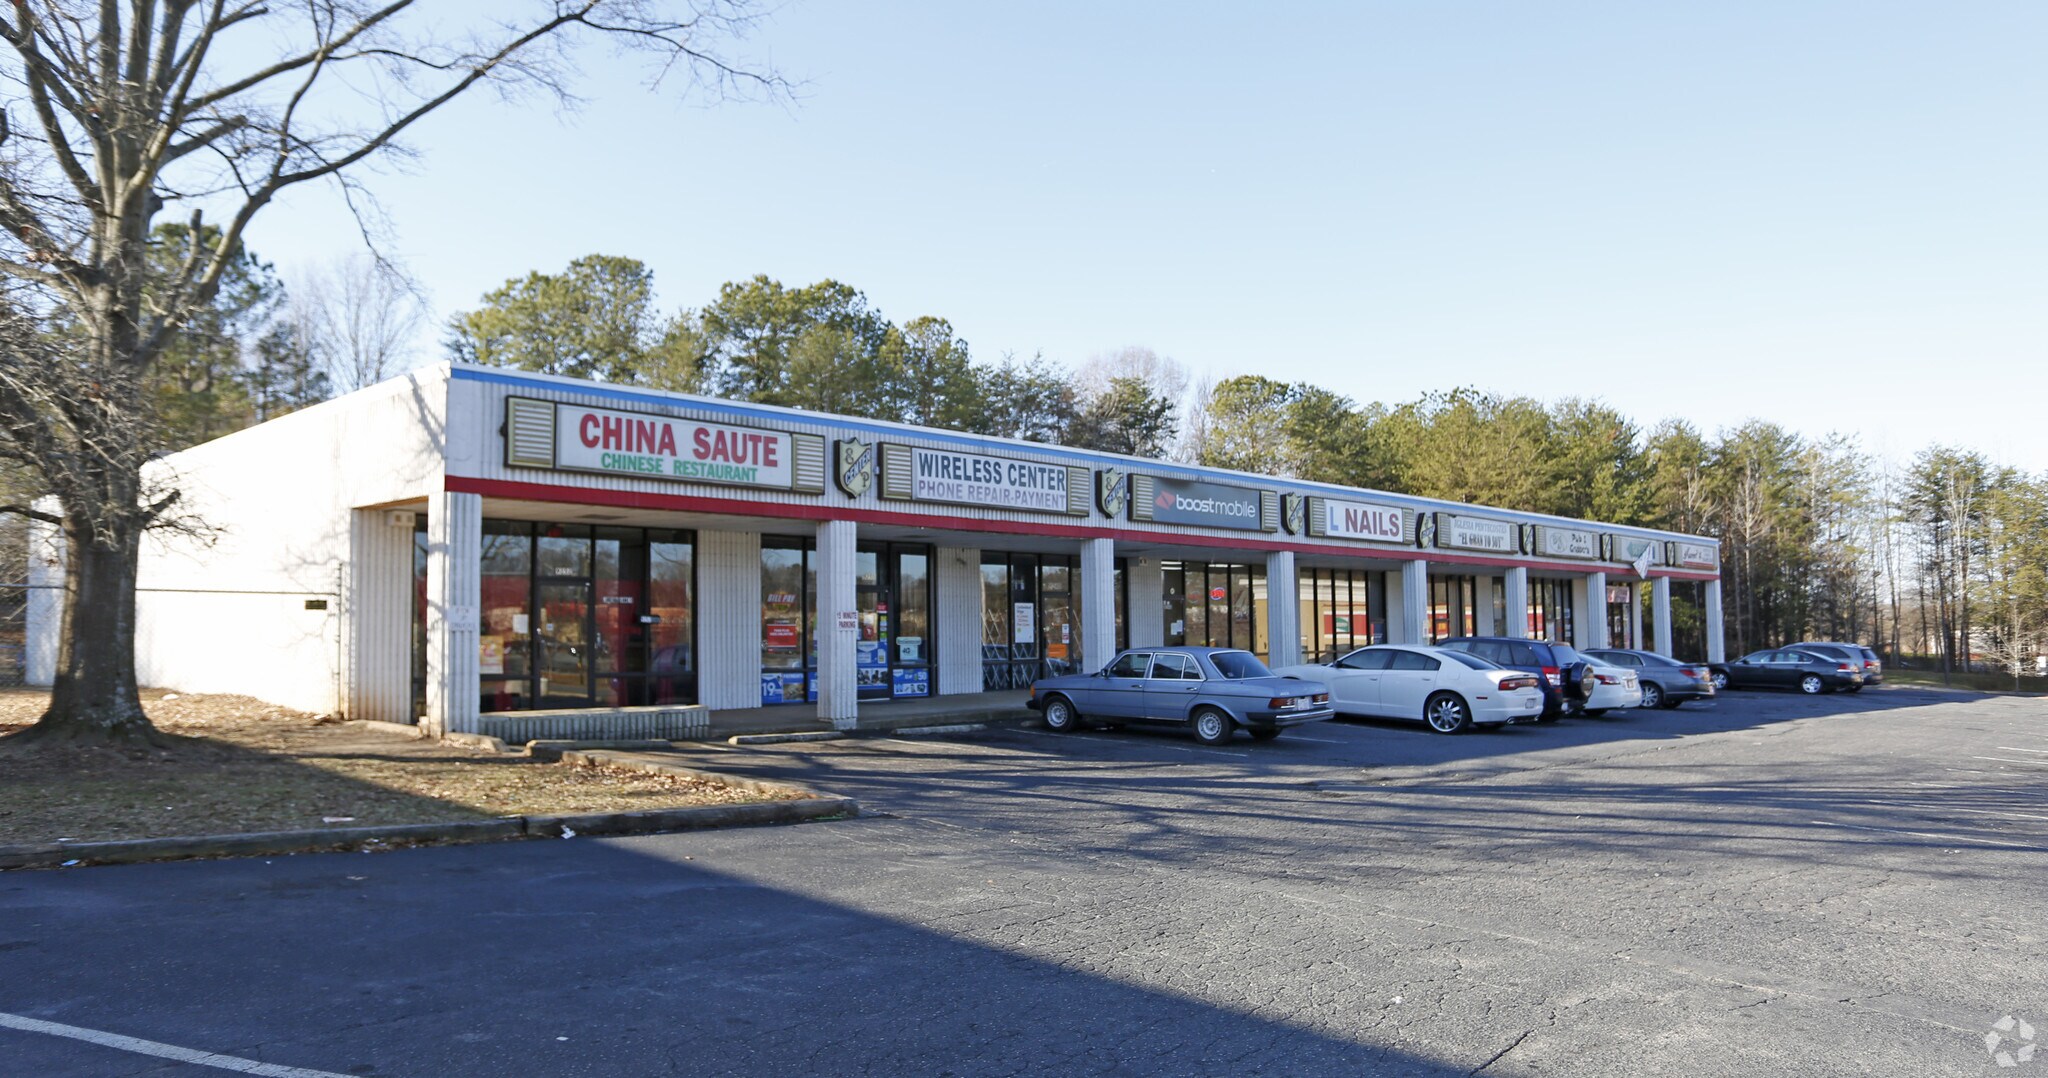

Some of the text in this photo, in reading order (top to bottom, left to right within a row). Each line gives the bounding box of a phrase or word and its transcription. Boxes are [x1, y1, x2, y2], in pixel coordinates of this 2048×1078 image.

[579, 413, 778, 468] CHINA SAUTE
[600, 452, 758, 482] CHINESE RESTAURANT
[918, 452, 1066, 492] WIRELESS CENTER
[918, 479, 1066, 510] PHONE REPAIR-PAYMENT
[1329, 506, 1339, 531] L
[1344, 508, 1400, 538] NAILS
[767, 594, 796, 603] BILL PAY
[838, 620, 856, 629] PARKING
[843, 611, 857, 620] MINUTE
